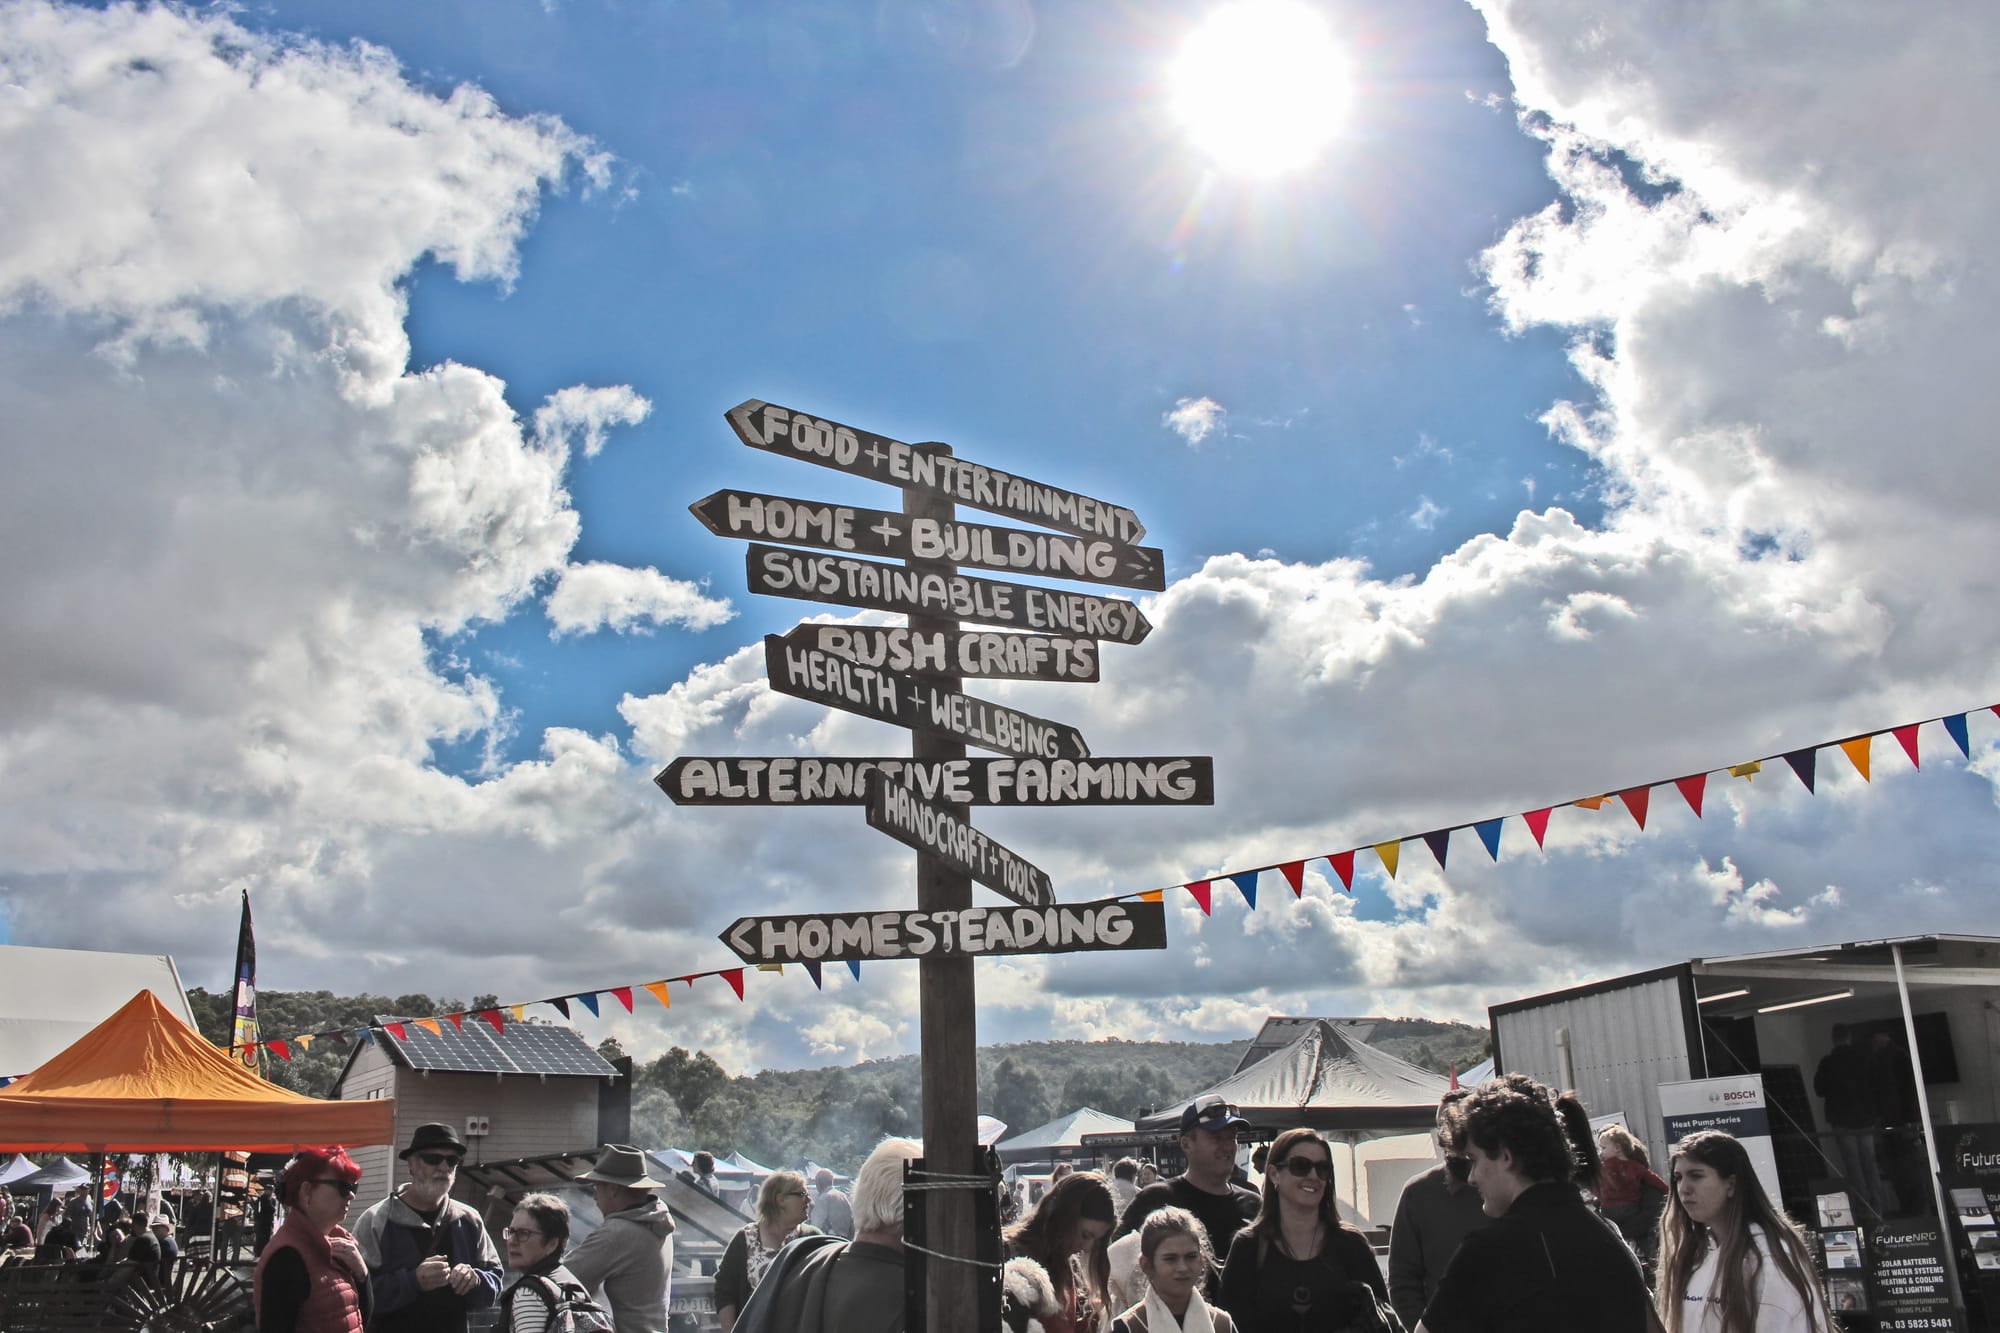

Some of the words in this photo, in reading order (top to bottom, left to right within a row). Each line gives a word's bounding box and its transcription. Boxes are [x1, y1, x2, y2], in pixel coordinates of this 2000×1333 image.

[763, 406, 859, 466] FOOD
[889, 441, 1139, 542] ENTERTAINMENT
[728, 494, 856, 550] HOME
[911, 518, 1117, 578] BUILDING
[762, 552, 1015, 621] SUSTAINABLE
[1025, 589, 1138, 641] ENERGY
[818, 627, 946, 672] BUSH
[958, 633, 1096, 678] CRAFTS
[785, 645, 898, 715] HEALTH
[930, 687, 1059, 759] WELLBEING
[987, 758, 1197, 804] FARMING
[884, 779, 988, 875] HANDCRAFT
[1000, 847, 1040, 906] TOOLS
[761, 907, 1134, 960] HOMESTEADING
[1723, 1090, 1757, 1101] BOSCH
[1672, 1121, 1691, 1129] Heat
[1692, 1119, 1715, 1128] Pump
[1715, 1116, 1742, 1125] Series
[1876, 1231, 1937, 1245] FutureNRG
[1878, 1269, 1890, 1277] HOT
[1891, 1268, 1913, 1276] WATER
[1914, 1266, 1944, 1275] SYSTEMS
[1881, 1260, 1902, 1268] SOLAR
[1903, 1257, 1937, 1266] BATTERIES
[1881, 1278, 1907, 1286] HEATING
[1915, 1276, 1944, 1284] COOLING
[1892, 1287, 1904, 1295] LED
[1905, 1285, 1935, 1294] LIGHTING
[1880, 1321, 1893, 1330] Ph.
[1895, 1320, 1906, 1329] 03
[1908, 1319, 1929, 1329] 5823
[1931, 1318, 1952, 1328] 5481
